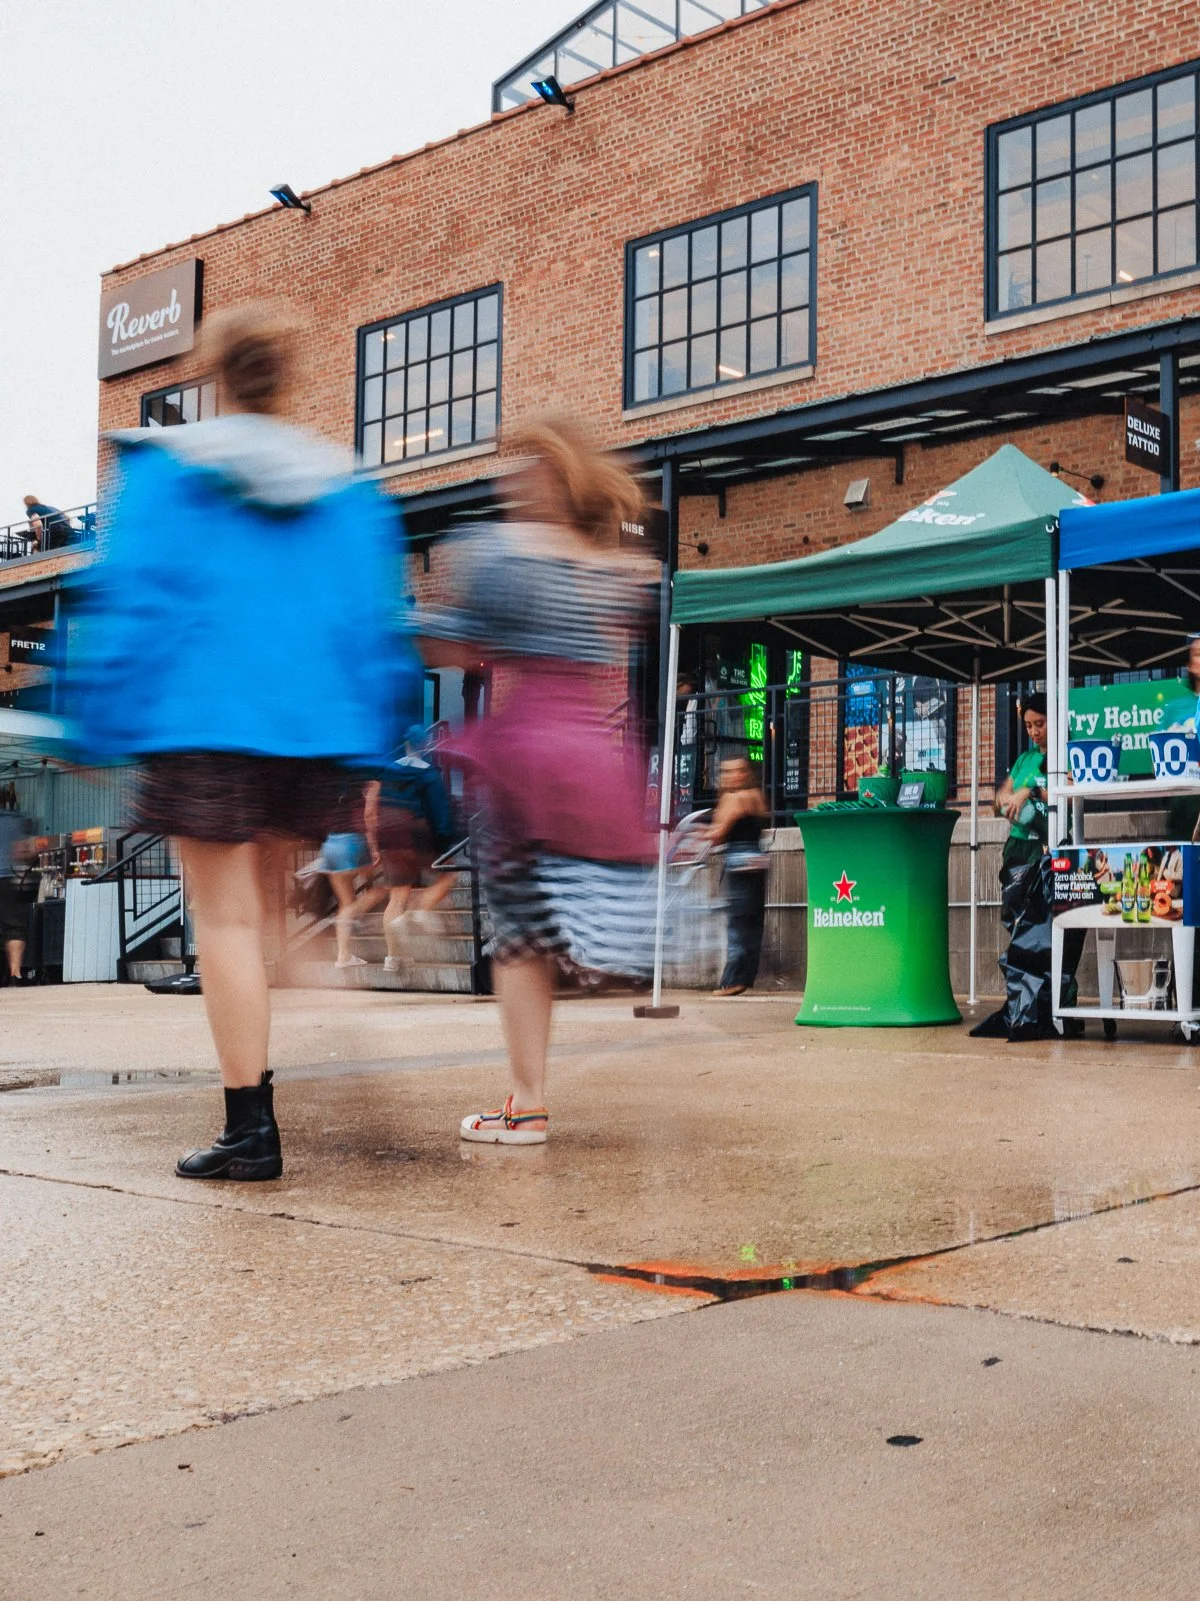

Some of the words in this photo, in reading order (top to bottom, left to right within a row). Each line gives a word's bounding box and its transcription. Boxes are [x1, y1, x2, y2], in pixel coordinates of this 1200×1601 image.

[106, 287, 182, 345] Reverb
[1127, 414, 1161, 441] DELUXE
[1127, 431, 1160, 456] TATTOO
[621, 520, 645, 537] RISE
[11, 639, 46, 651] FRET12
[1103, 703, 1164, 729] Heine
[1069, 746, 1113, 783] 0.0
[1053, 861, 1066, 869] NEW
[1054, 872, 1069, 881] Zero
[1069, 871, 1094, 881] alcohol.
[1054, 881, 1069, 891] New
[1070, 880, 1098, 891] flavors.
[1054, 892, 1069, 900] Now
[1069, 892, 1081, 902] you
[1081, 891, 1094, 900] can
[813, 906, 886, 928] Heineken
